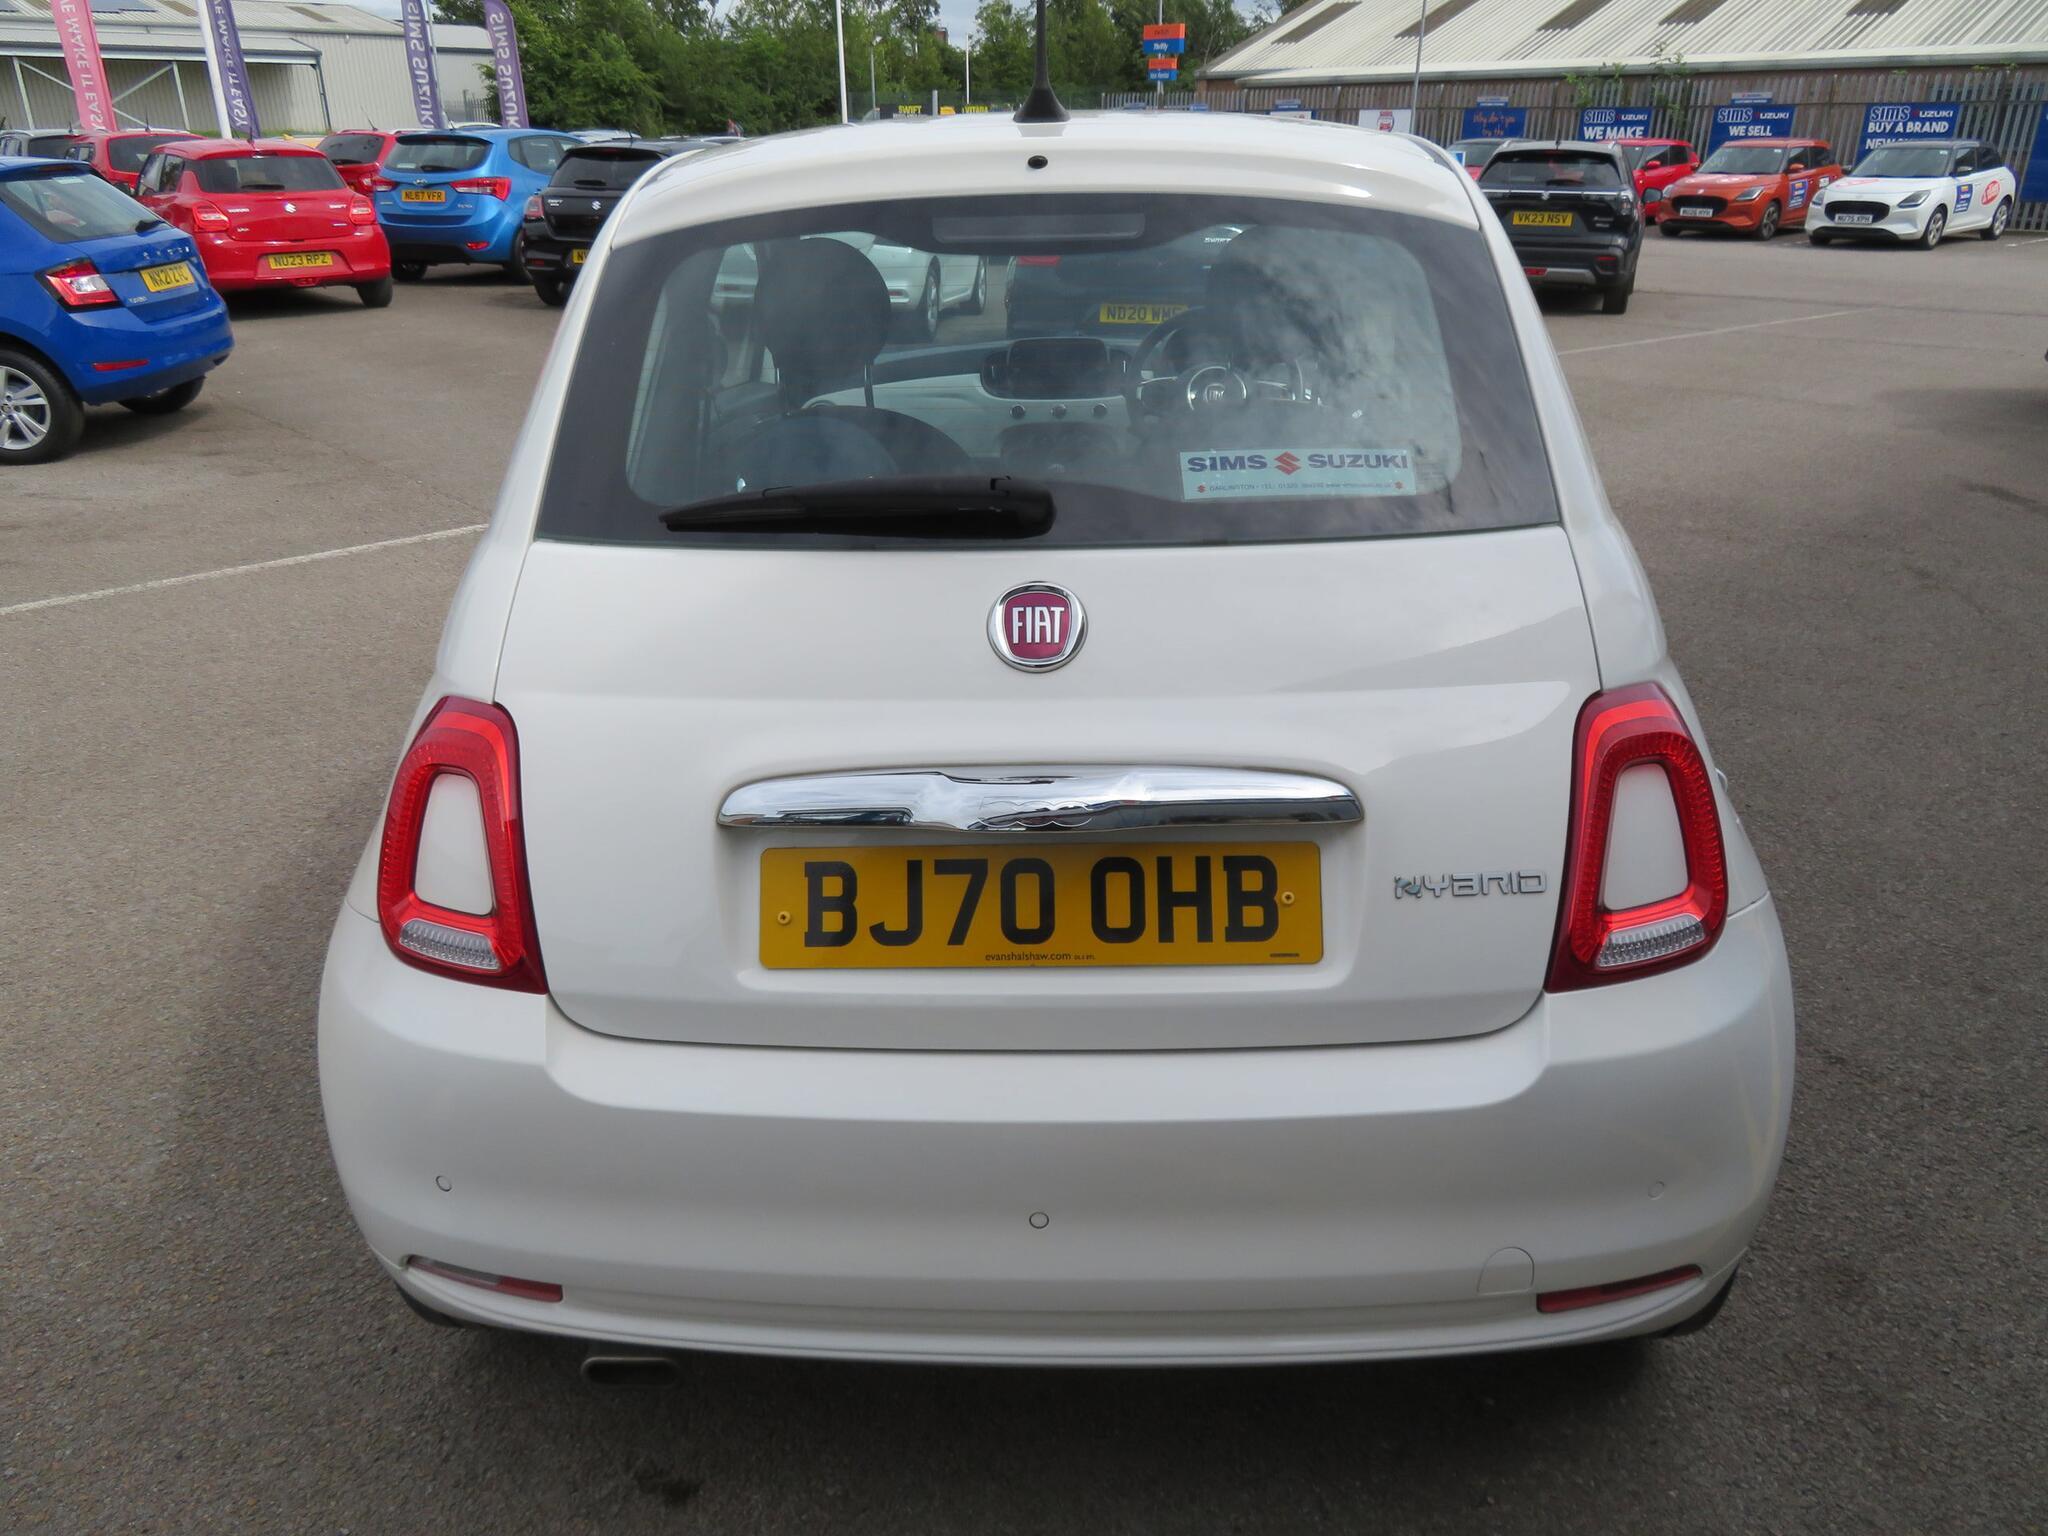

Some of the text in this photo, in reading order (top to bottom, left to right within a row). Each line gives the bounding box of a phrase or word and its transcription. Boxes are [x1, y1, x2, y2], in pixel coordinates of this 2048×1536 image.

[898, 104, 922, 114] SWIFT
[1583, 108, 1616, 124] SIMS
[1717, 107, 1753, 123] SIMS
[1870, 105, 1911, 122] SIMS
[1583, 126, 1645, 140] WE MAKE
[1729, 125, 1772, 136] WE SELL
[1867, 121, 1949, 133] BUY A BRAND
[1518, 212, 1568, 223] VK23 NSV
[273, 253, 328, 266] NU23 RPZ
[1107, 306, 1147, 320] ND20
[1187, 453, 1409, 473] SIMS SUZUKI
[1012, 606, 1065, 644] FIAT
[1394, 869, 1548, 900] HYBRID
[803, 855, 1280, 948] BJ70 OHB
[985, 951, 1072, 962] evanshalshaw.com
